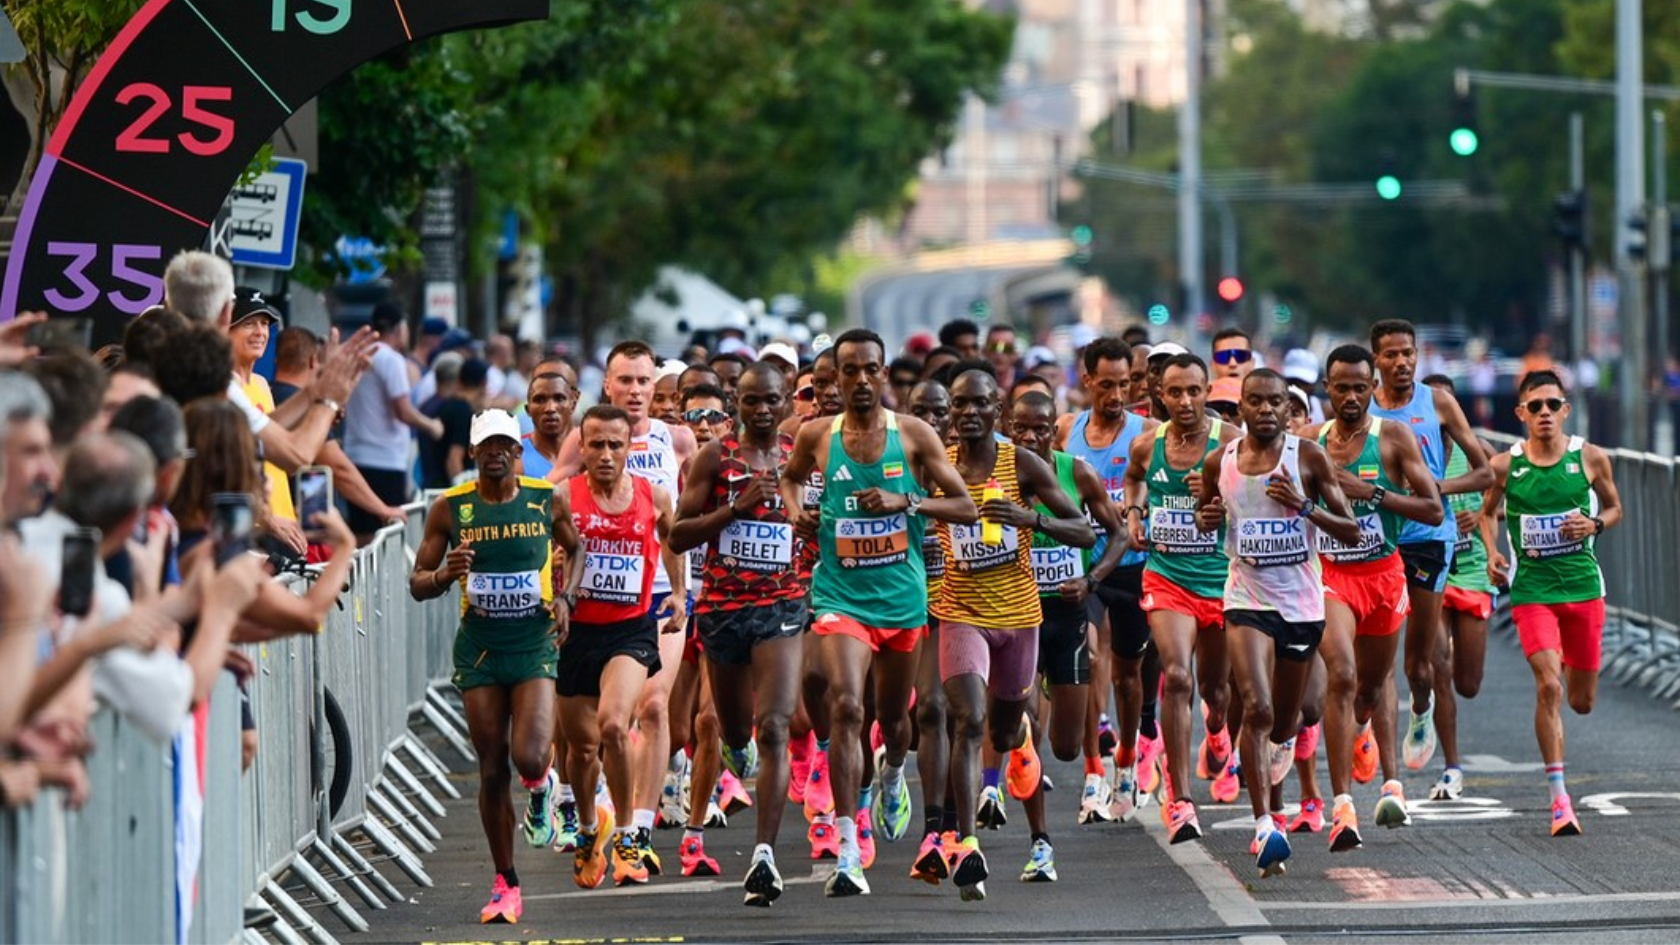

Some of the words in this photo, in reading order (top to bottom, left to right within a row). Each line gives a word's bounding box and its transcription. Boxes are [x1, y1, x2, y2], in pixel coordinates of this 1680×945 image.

[115, 82, 235, 156] 25
[43, 241, 164, 313] 35
[1163, 495, 1198, 509] ETHIOP
[854, 515, 901, 535] TDK
[1167, 511, 1195, 525] TD
[1255, 518, 1300, 535] TDK
[1536, 515, 1571, 529] TD
[460, 526, 499, 543] SOUTH
[503, 521, 547, 540] AFRICA
[741, 522, 786, 540] TDK
[1153, 526, 1214, 542] GEBRESILASE
[1522, 532, 1557, 546] SANTANA
[583, 536, 641, 554] TÜRKİYE
[731, 539, 780, 559] BELET
[851, 537, 895, 554] TOLA
[961, 538, 1007, 558] KISSA
[1240, 535, 1305, 554] HAKIZIMANA
[594, 555, 638, 571] TDK
[1032, 547, 1075, 563] TDK
[486, 574, 533, 590] TDK
[593, 572, 626, 590] CAN
[477, 593, 531, 608] FRANS
